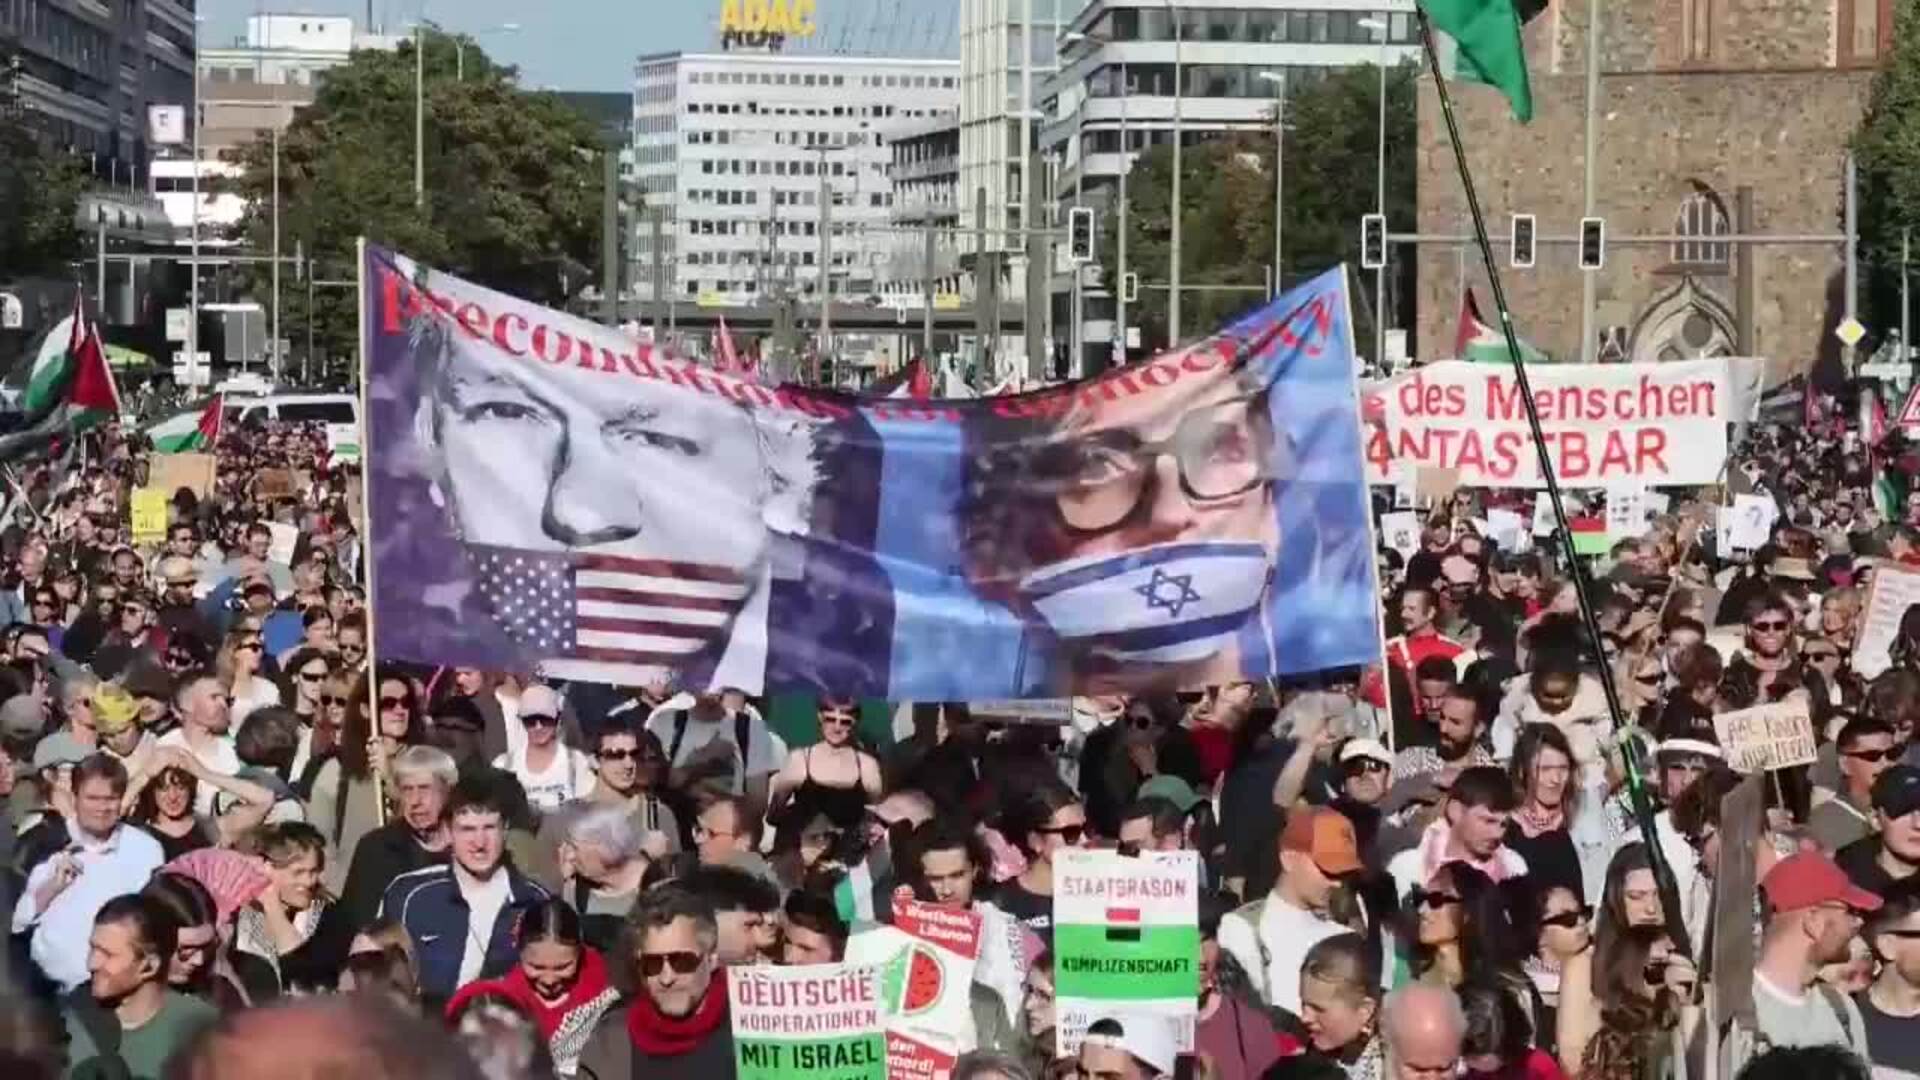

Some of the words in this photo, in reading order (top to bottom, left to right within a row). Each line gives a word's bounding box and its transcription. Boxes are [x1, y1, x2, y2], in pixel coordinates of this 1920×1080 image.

[720, 0, 817, 36] ADAC
[1401, 372, 1466, 416] des
[1487, 374, 1717, 422] Menschen
[738, 977, 875, 1007] DEUTSCHE
[739, 1009, 877, 1032] KOOPERATIONEN
[741, 1042, 781, 1069] MIT
[792, 1039, 879, 1069] ISRAEL
